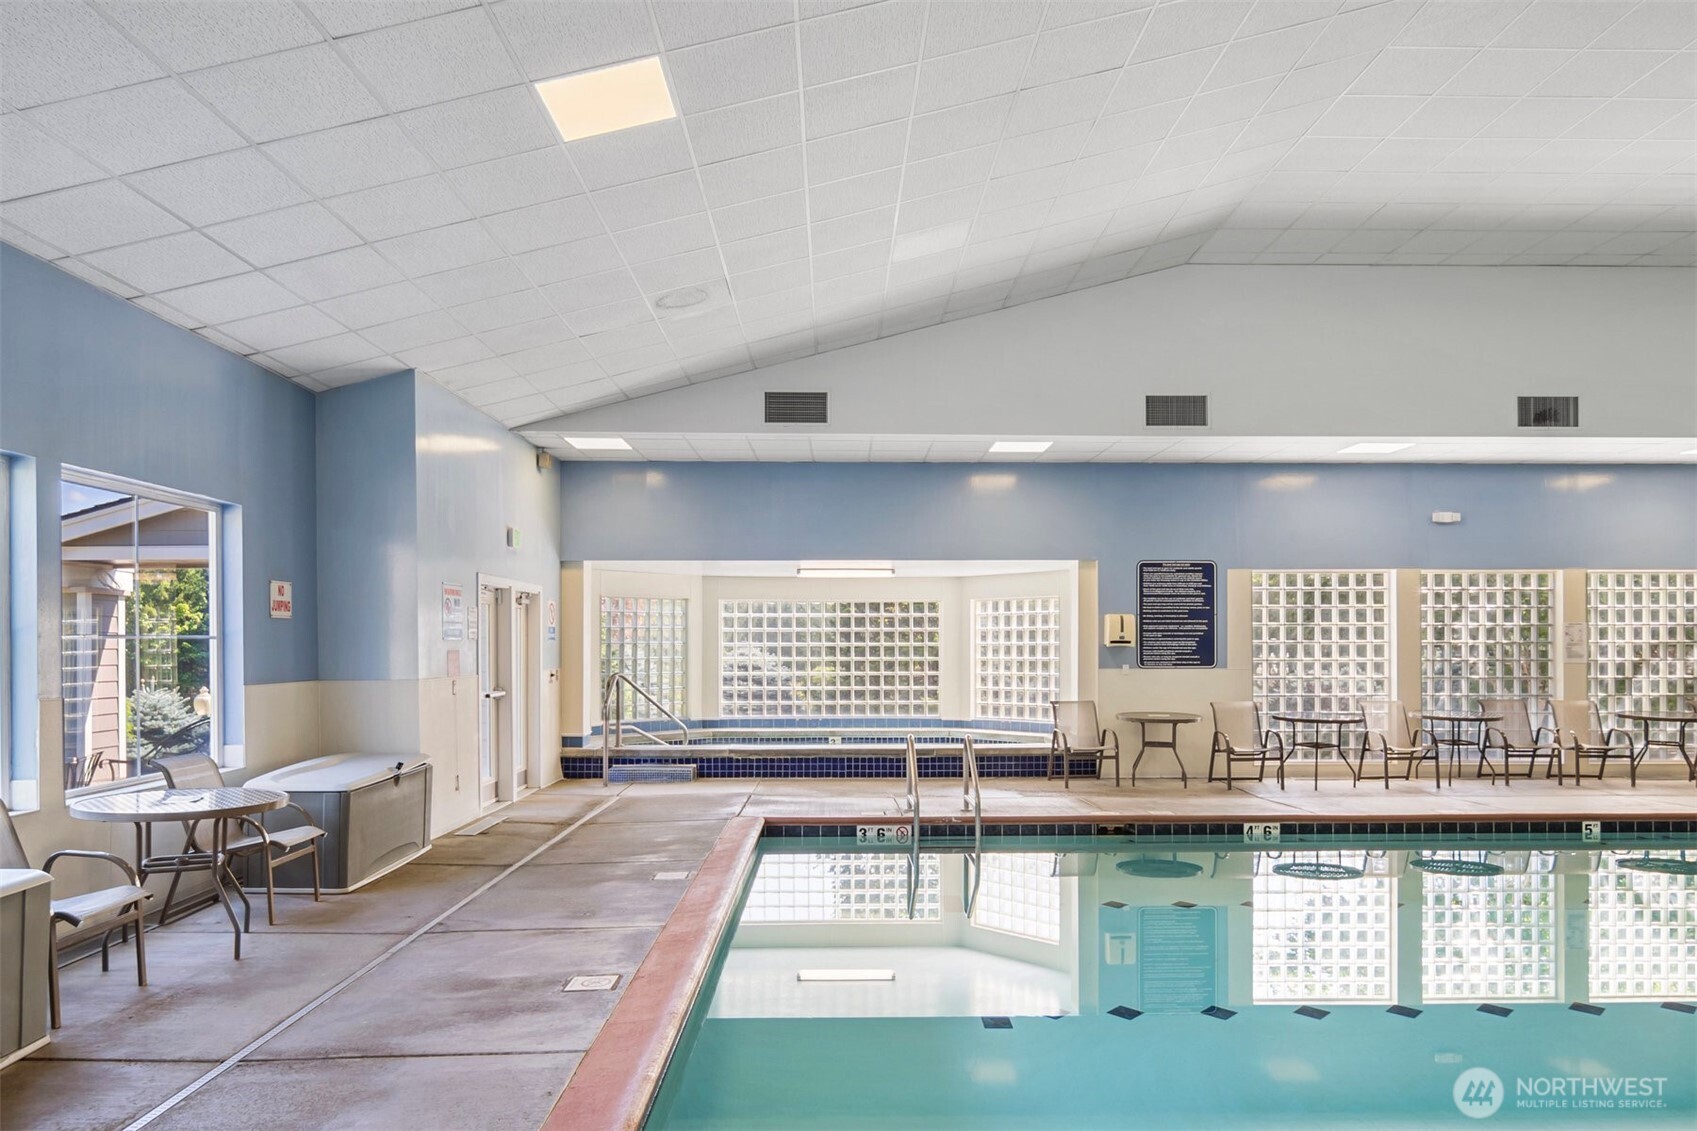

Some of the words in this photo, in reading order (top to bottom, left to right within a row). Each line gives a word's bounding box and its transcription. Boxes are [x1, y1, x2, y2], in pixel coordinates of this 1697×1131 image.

[278, 584, 285, 596] NO
[272, 600, 290, 612] JUMPING
[859, 828, 867, 838] 3
[877, 828, 885, 838] 6
[1246, 825, 1253, 835] 4
[1264, 825, 1272, 836] 6
[1585, 824, 1592, 834] 5
